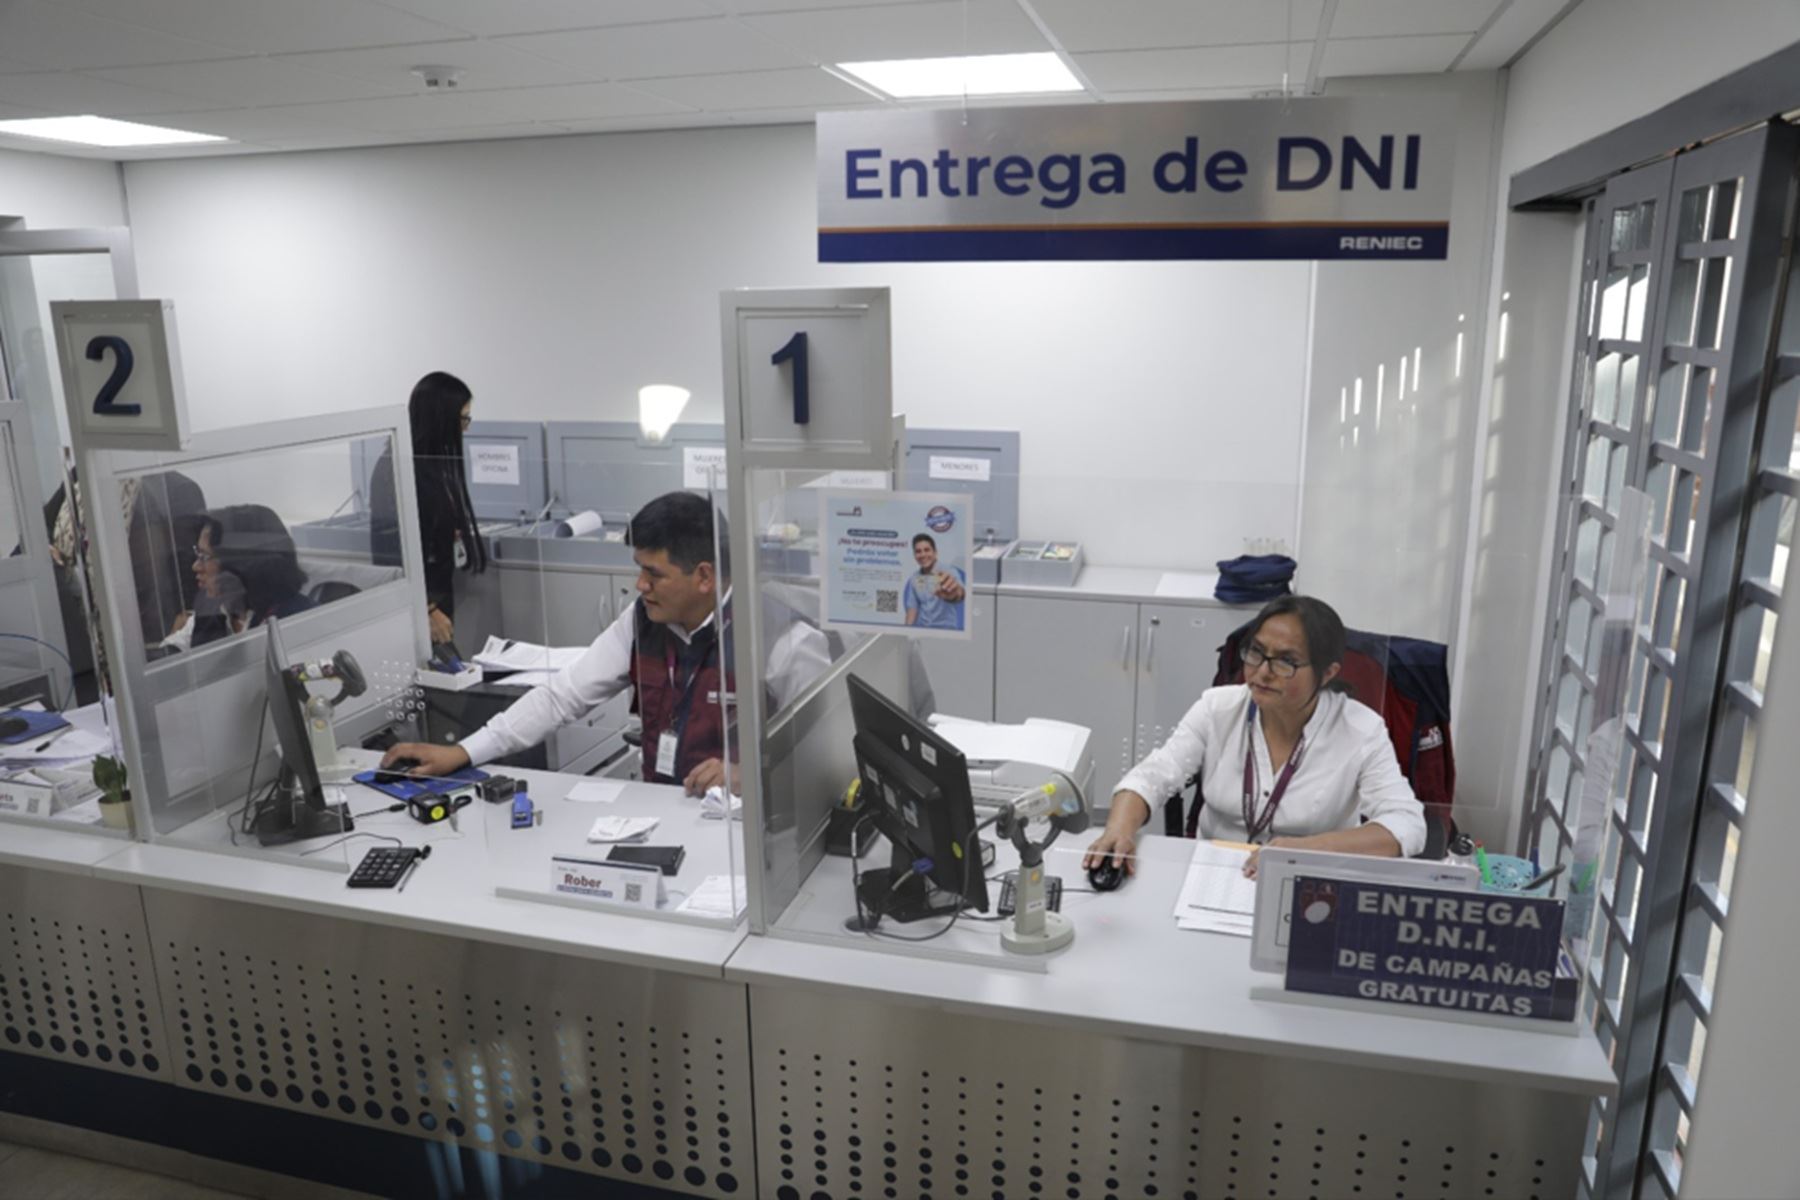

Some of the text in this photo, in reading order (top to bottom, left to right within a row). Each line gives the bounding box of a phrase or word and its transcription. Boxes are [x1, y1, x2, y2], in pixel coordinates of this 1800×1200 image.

[845, 134, 1421, 209] Entrega de DNI
[1340, 236, 1423, 250] RENIEC
[85, 335, 142, 416] 2
[771, 331, 810, 425] 1
[940, 462, 979, 471] MENORES
[564, 873, 602, 888] Rober
[1357, 890, 1542, 930] ENTREGA
[1397, 921, 1497, 954] D.N.I.
[1338, 949, 1552, 989] DE CAMPAÑAS
[1358, 979, 1533, 1017] GRATUITAS
